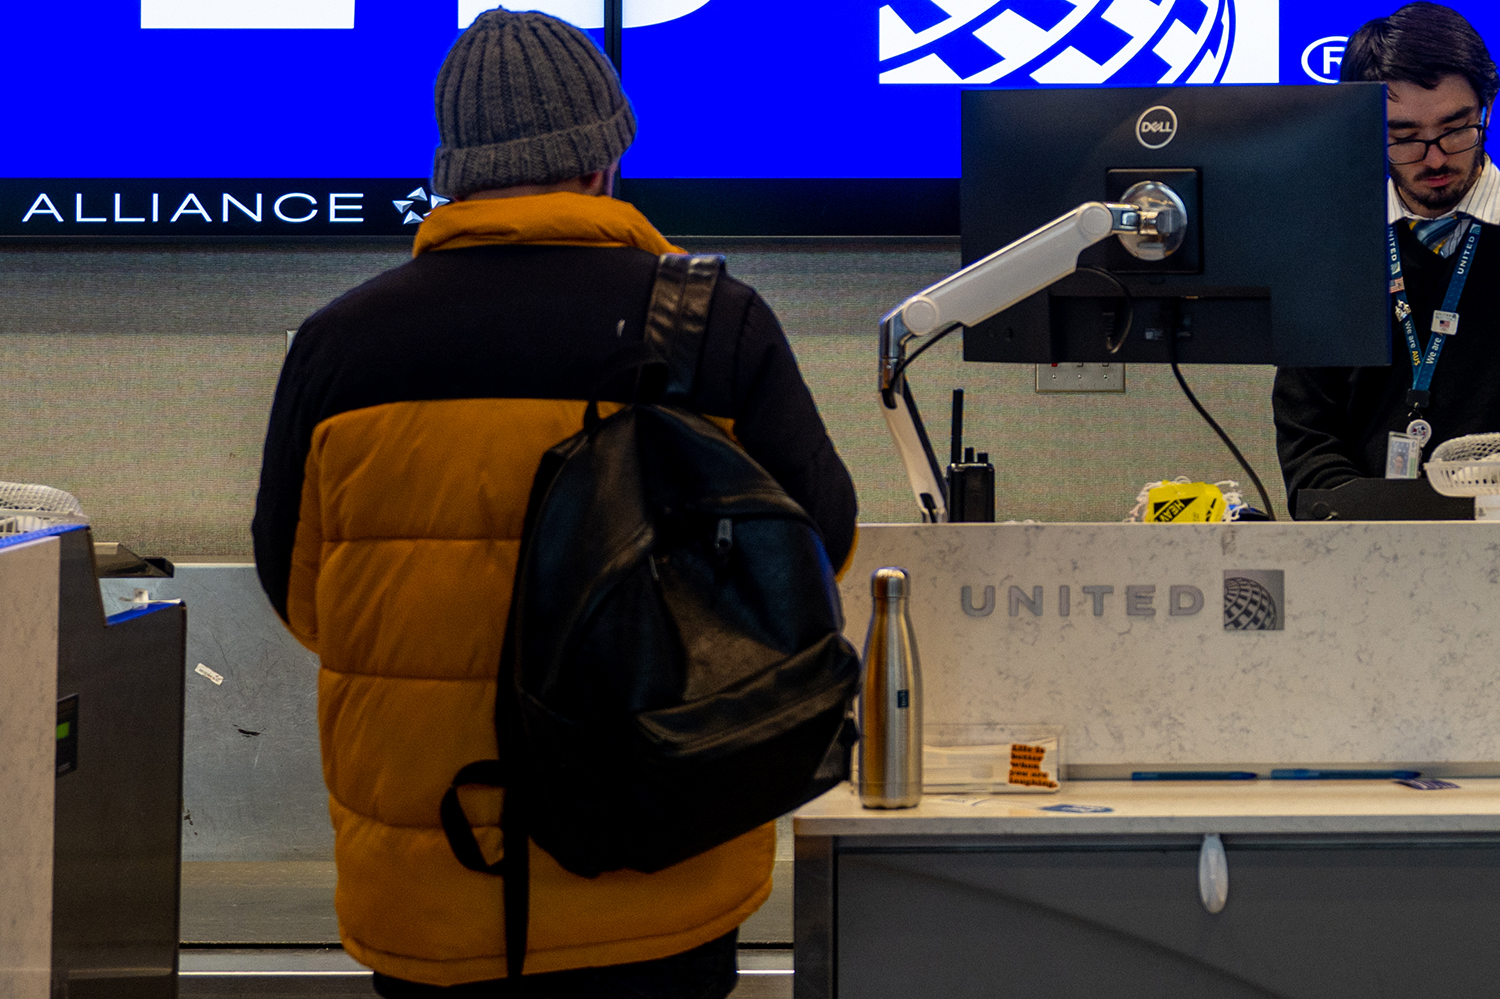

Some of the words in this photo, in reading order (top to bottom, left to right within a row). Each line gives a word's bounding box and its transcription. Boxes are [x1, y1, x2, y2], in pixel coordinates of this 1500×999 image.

[1141, 121, 1172, 133] DELL
[23, 193, 363, 222] ALLIANCE
[1457, 236, 1475, 275] UNITED
[1404, 320, 1412, 335] We
[1408, 335, 1416, 349] are
[1412, 350, 1421, 366] AUS
[1426, 348, 1436, 365] We
[1432, 337, 1442, 351] are
[960, 585, 1206, 617] UNITED
